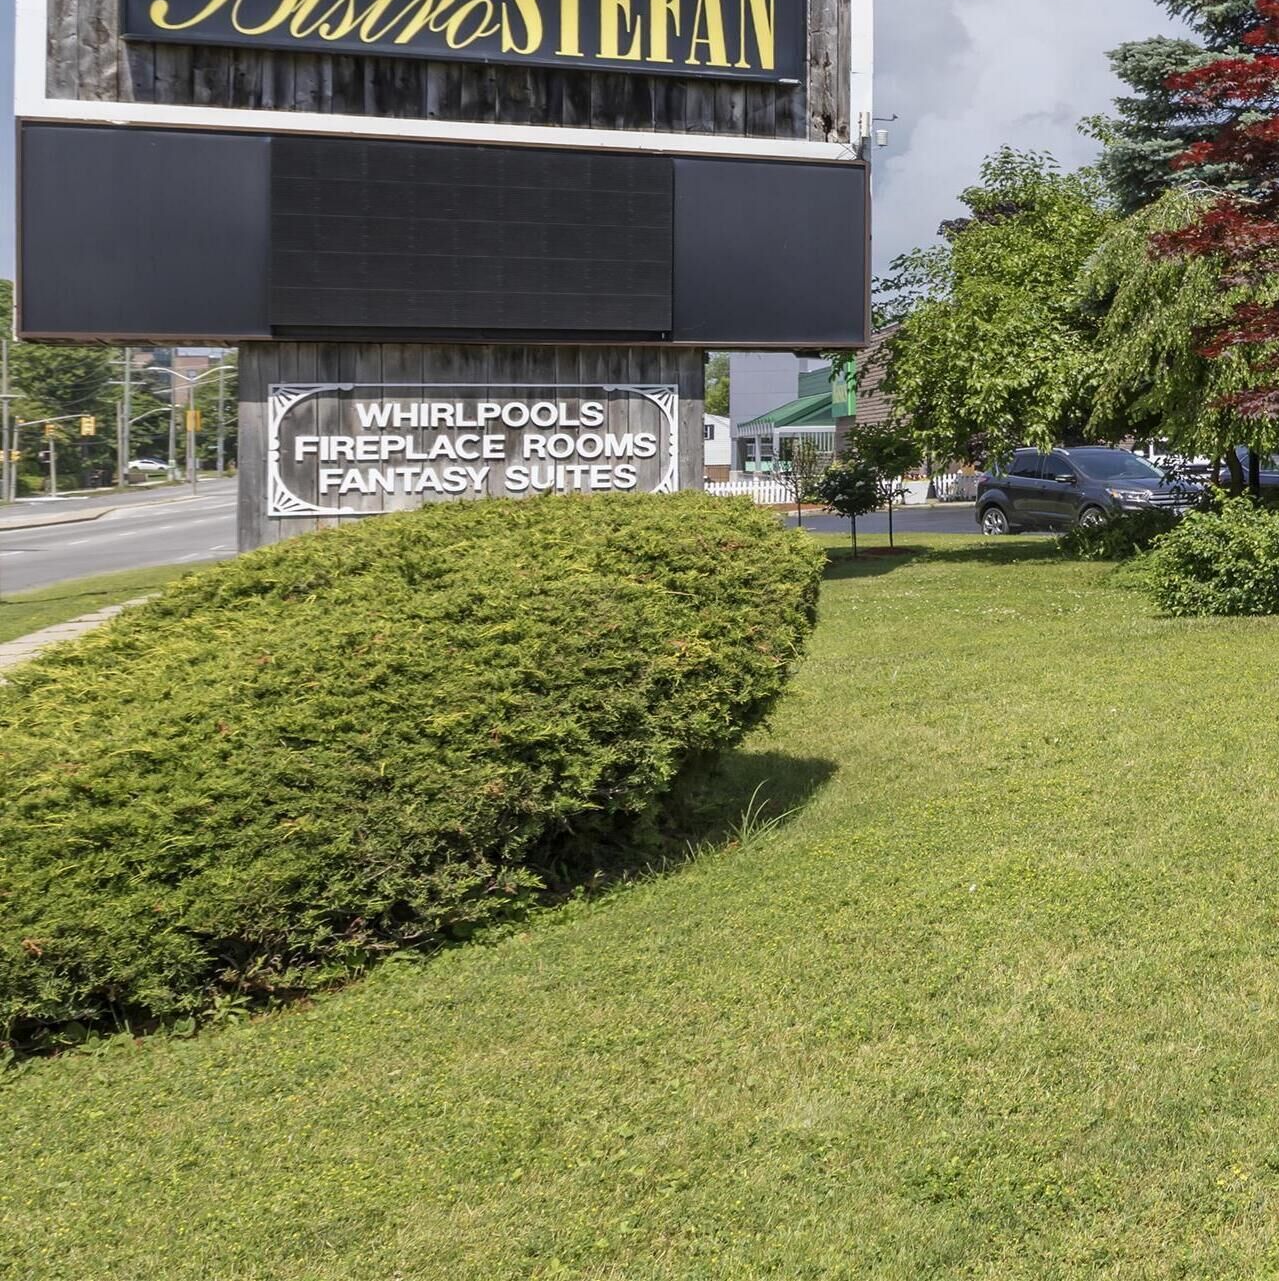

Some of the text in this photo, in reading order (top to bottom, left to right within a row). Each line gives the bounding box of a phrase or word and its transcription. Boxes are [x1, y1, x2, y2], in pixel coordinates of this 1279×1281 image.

[356, 401, 605, 429] WHIRLPOOLS
[295, 432, 657, 462] FIREPLACE ROOMS
[318, 463, 638, 495] FANTASY SUITES
